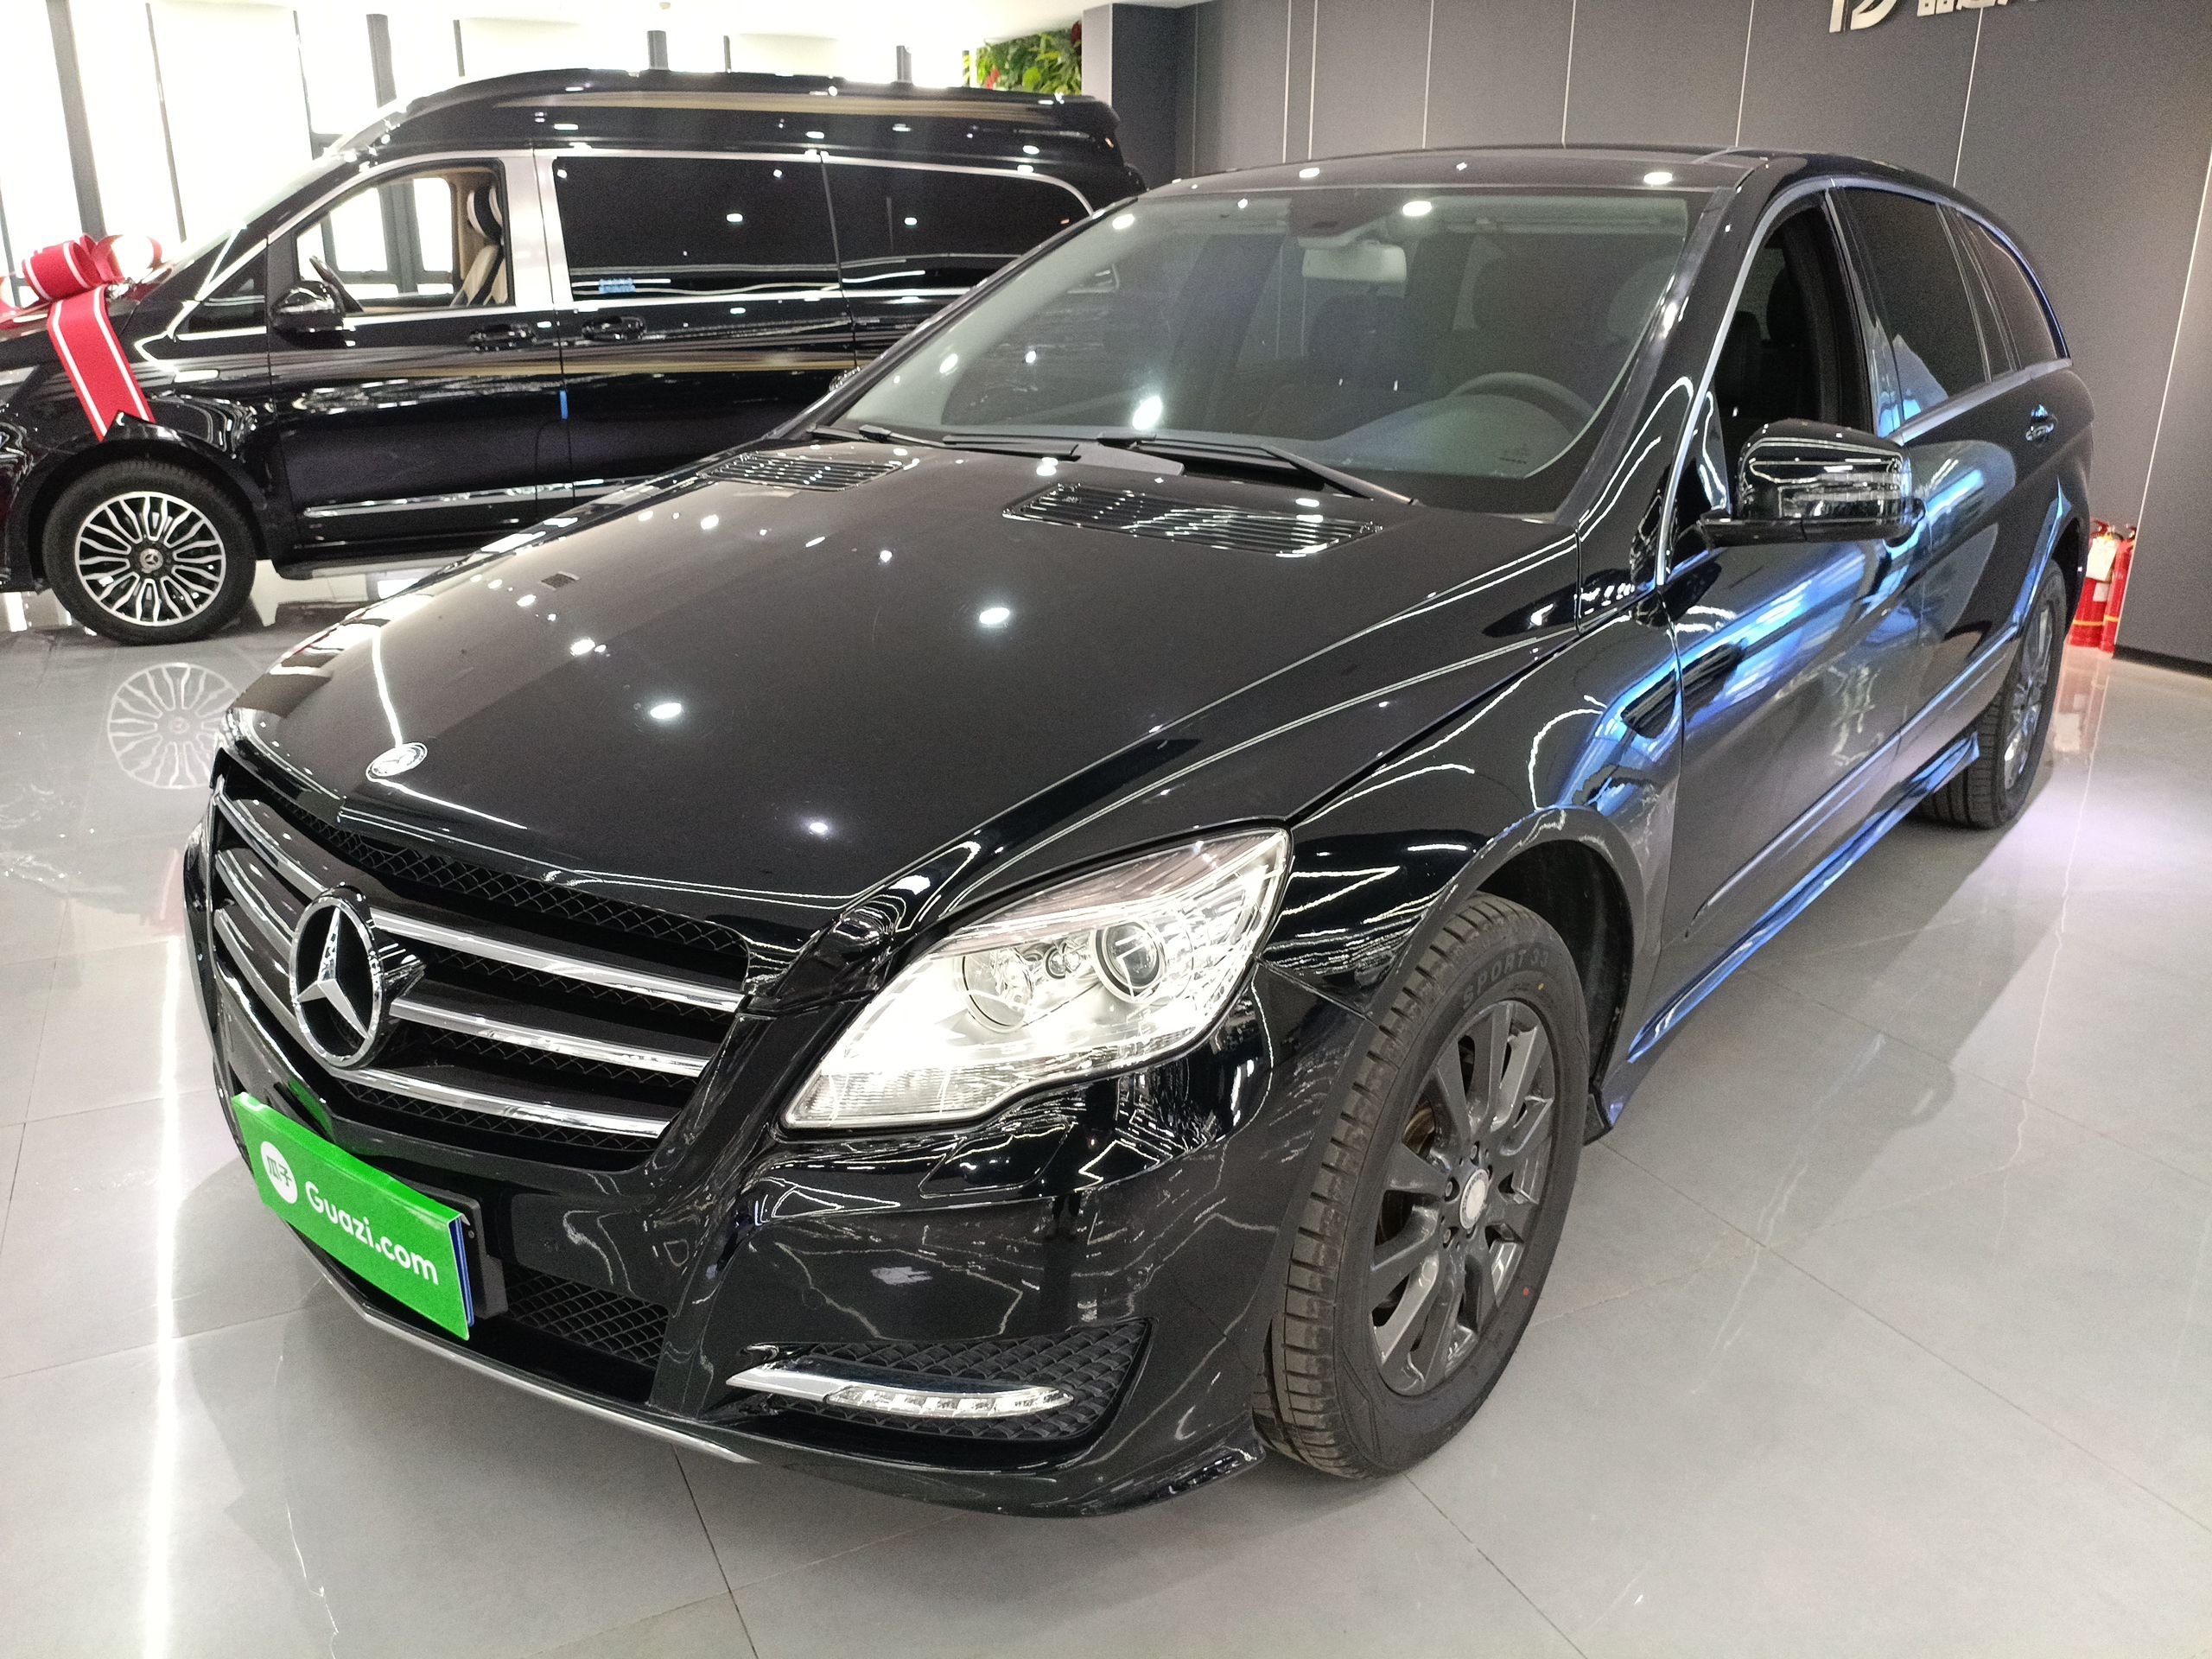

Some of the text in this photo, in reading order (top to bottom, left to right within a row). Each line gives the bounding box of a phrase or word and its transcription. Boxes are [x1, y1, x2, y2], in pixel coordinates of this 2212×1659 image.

[1463, 949, 1527, 1010] SPORT
[266, 1155, 293, 1187] 瓜子
[305, 1180, 439, 1286] Guazi.com
